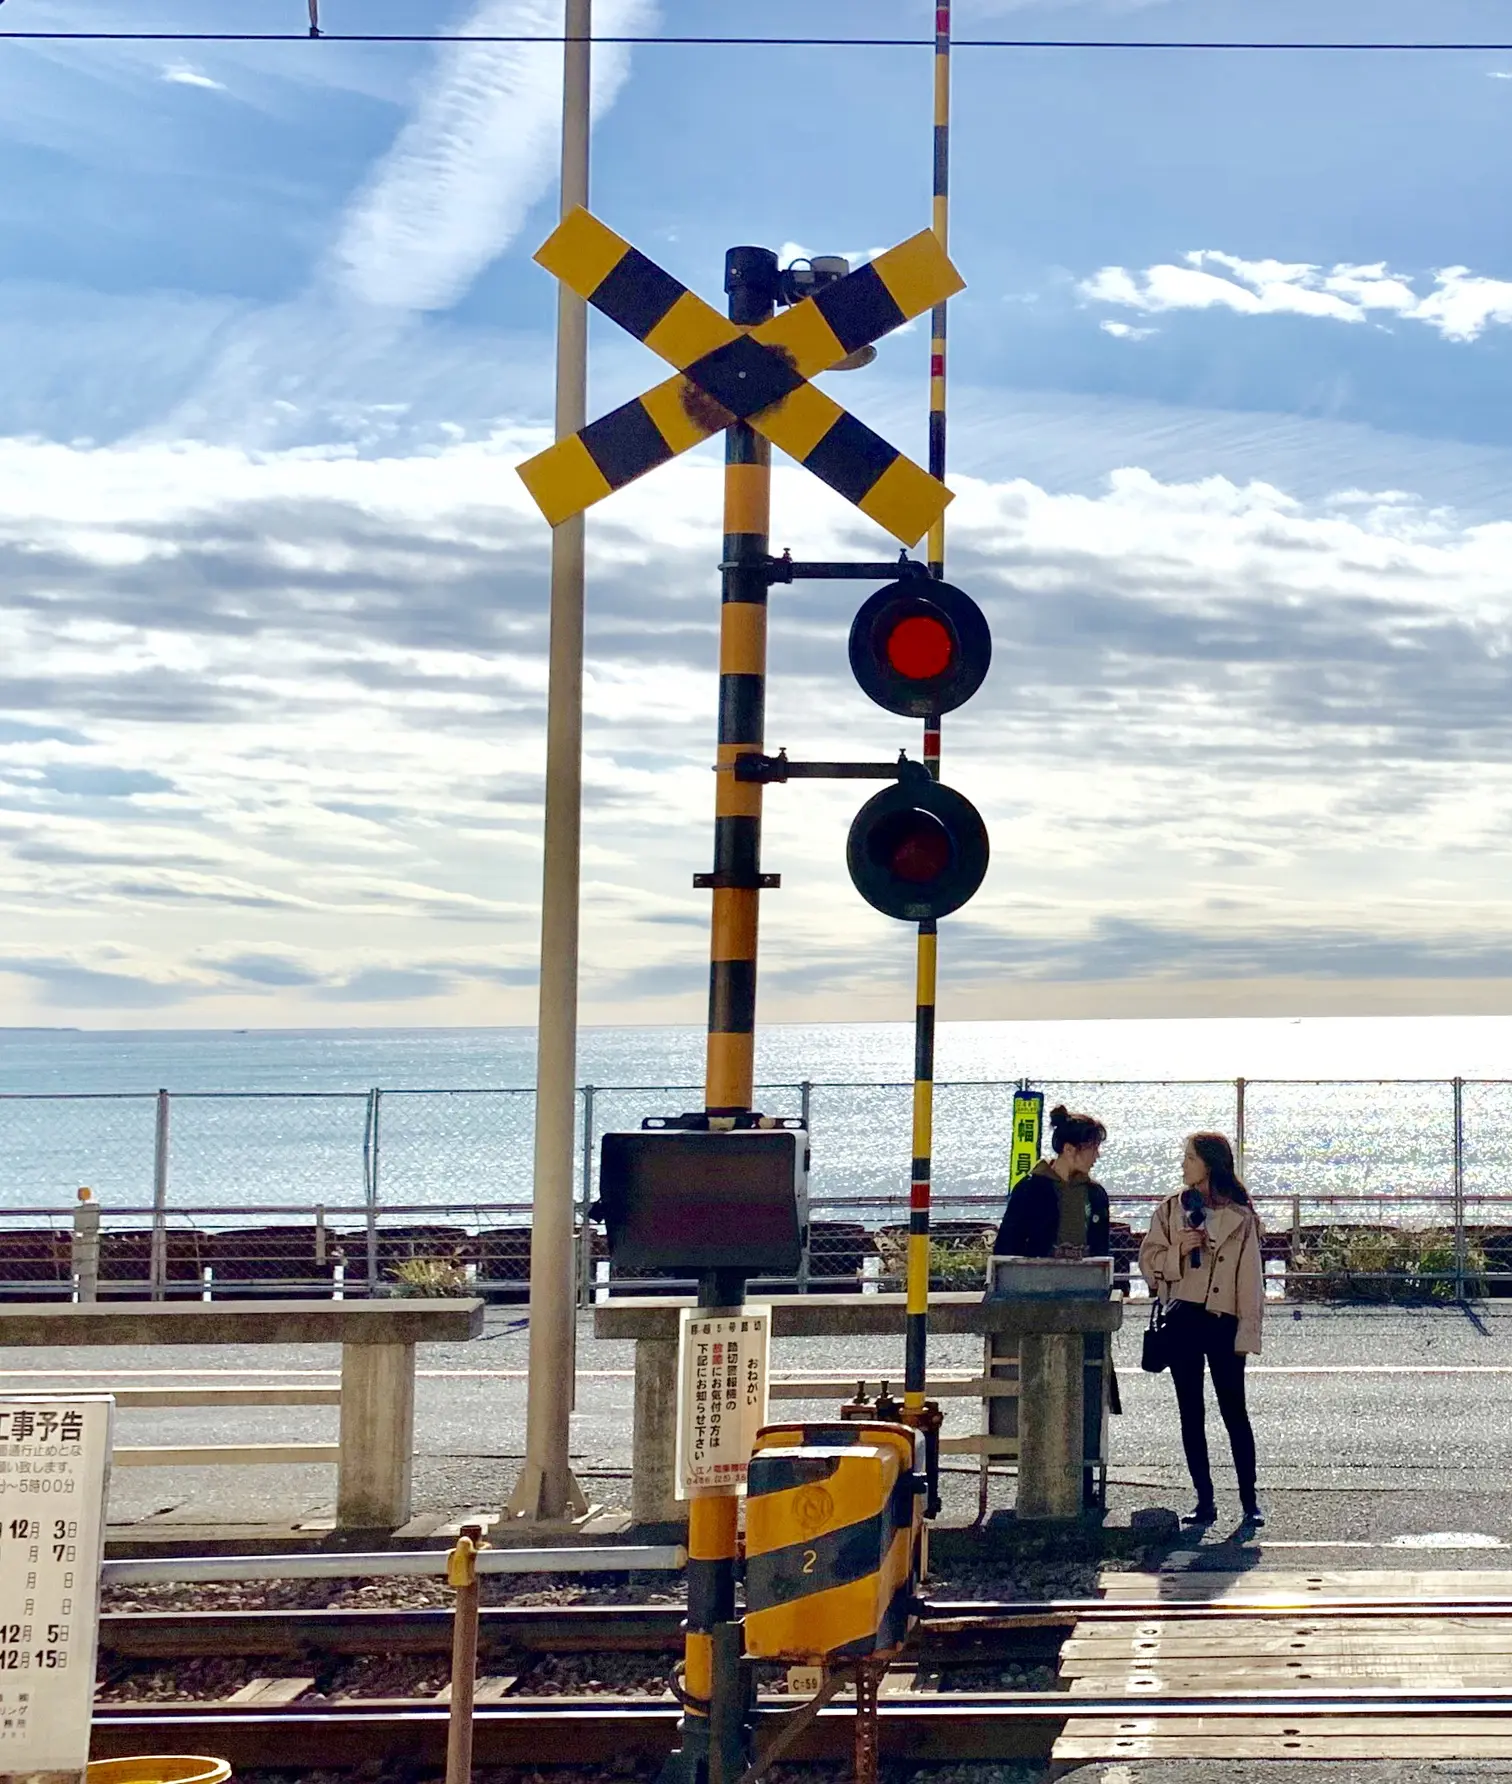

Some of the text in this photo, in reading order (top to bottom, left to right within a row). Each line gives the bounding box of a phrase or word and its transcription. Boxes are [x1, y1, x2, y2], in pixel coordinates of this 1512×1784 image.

[726, 1342, 738, 1411] 踏切警報機の
[746, 1358, 758, 1405] おねがい
[694, 1343, 709, 1461] 下記にお知らせ下さい
[709, 1343, 723, 1448] 故障にお気付の方は
[28, 1545, 39, 1563] 月
[802, 1550, 818, 1574] 2
[25, 1571, 73, 1589] 月 日
[23, 1598, 71, 1616] 月 日
